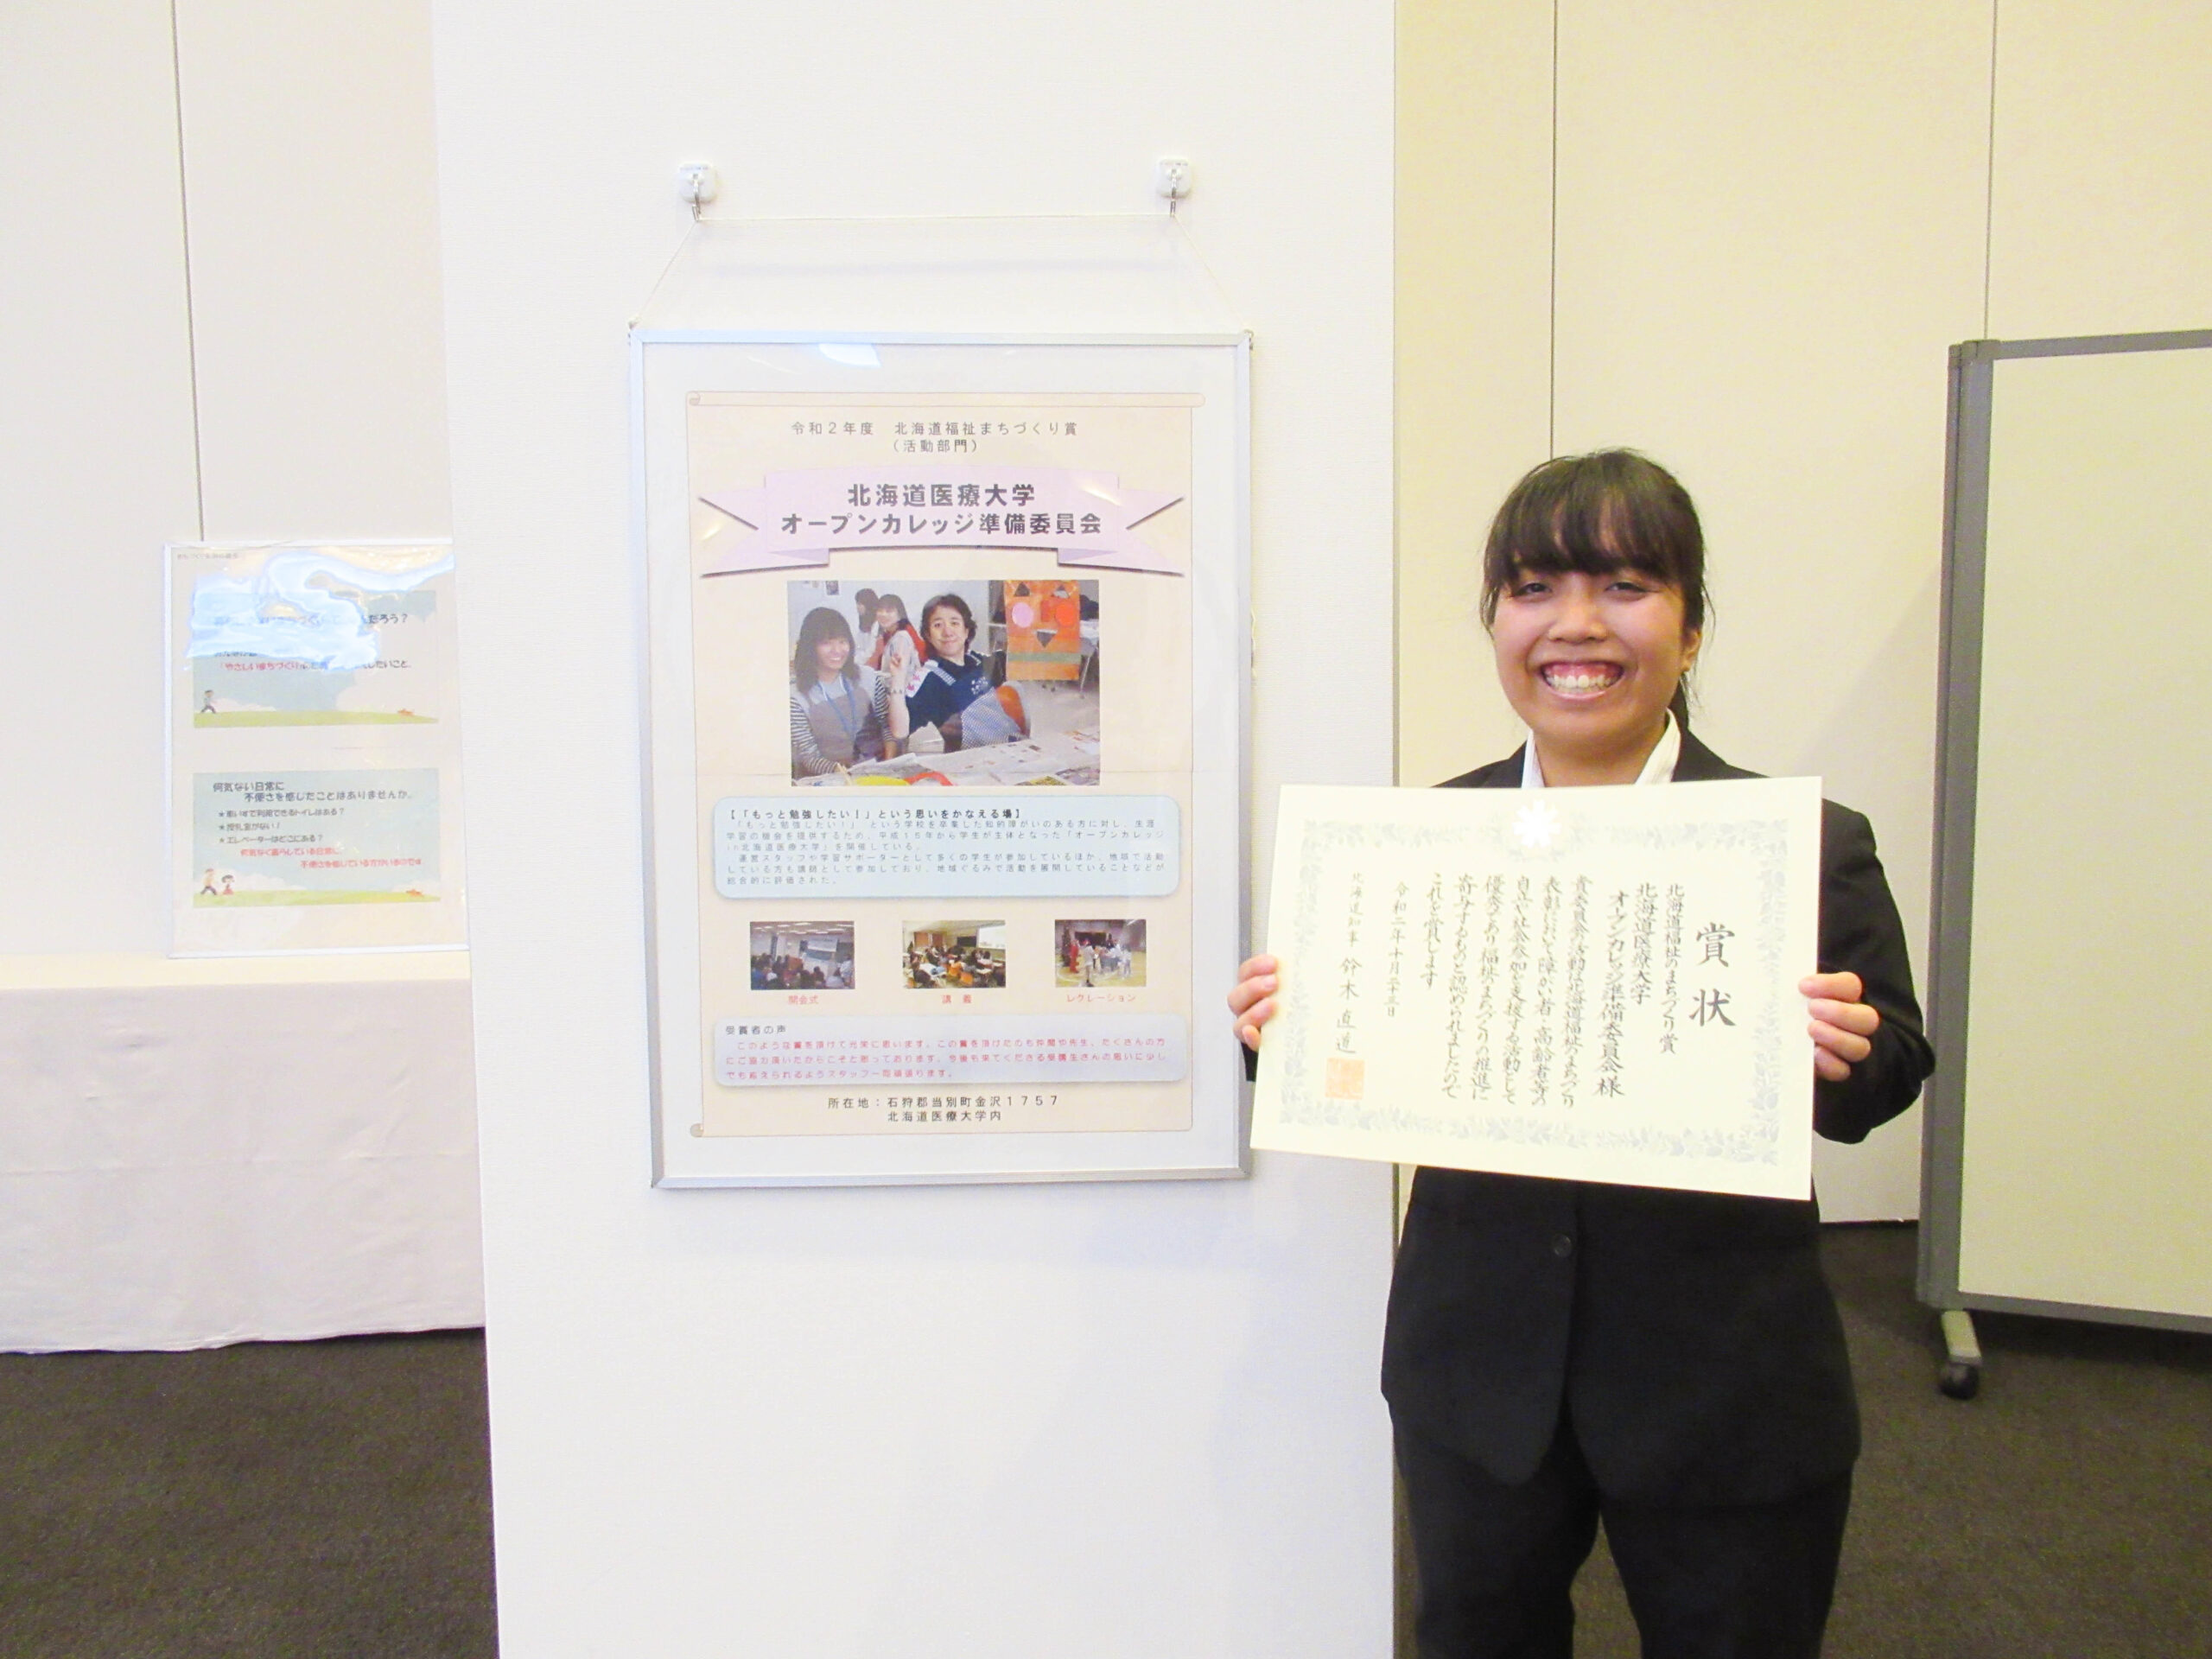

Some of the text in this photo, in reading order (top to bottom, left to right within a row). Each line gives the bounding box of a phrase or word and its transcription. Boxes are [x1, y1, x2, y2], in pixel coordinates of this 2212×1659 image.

[893, 421, 1078, 436] 北海道福祉まちづくり賞
[847, 483, 1036, 507] 北海道医療大学
[780, 512, 1103, 535] オープンカレッジ準備委員会
[1630, 882, 1658, 1005] 北海道医療大学
[1658, 883, 1685, 1054] 北海道福祉のまちづくり賞
[887, 1109, 1001, 1122] 北海道医療大学内
